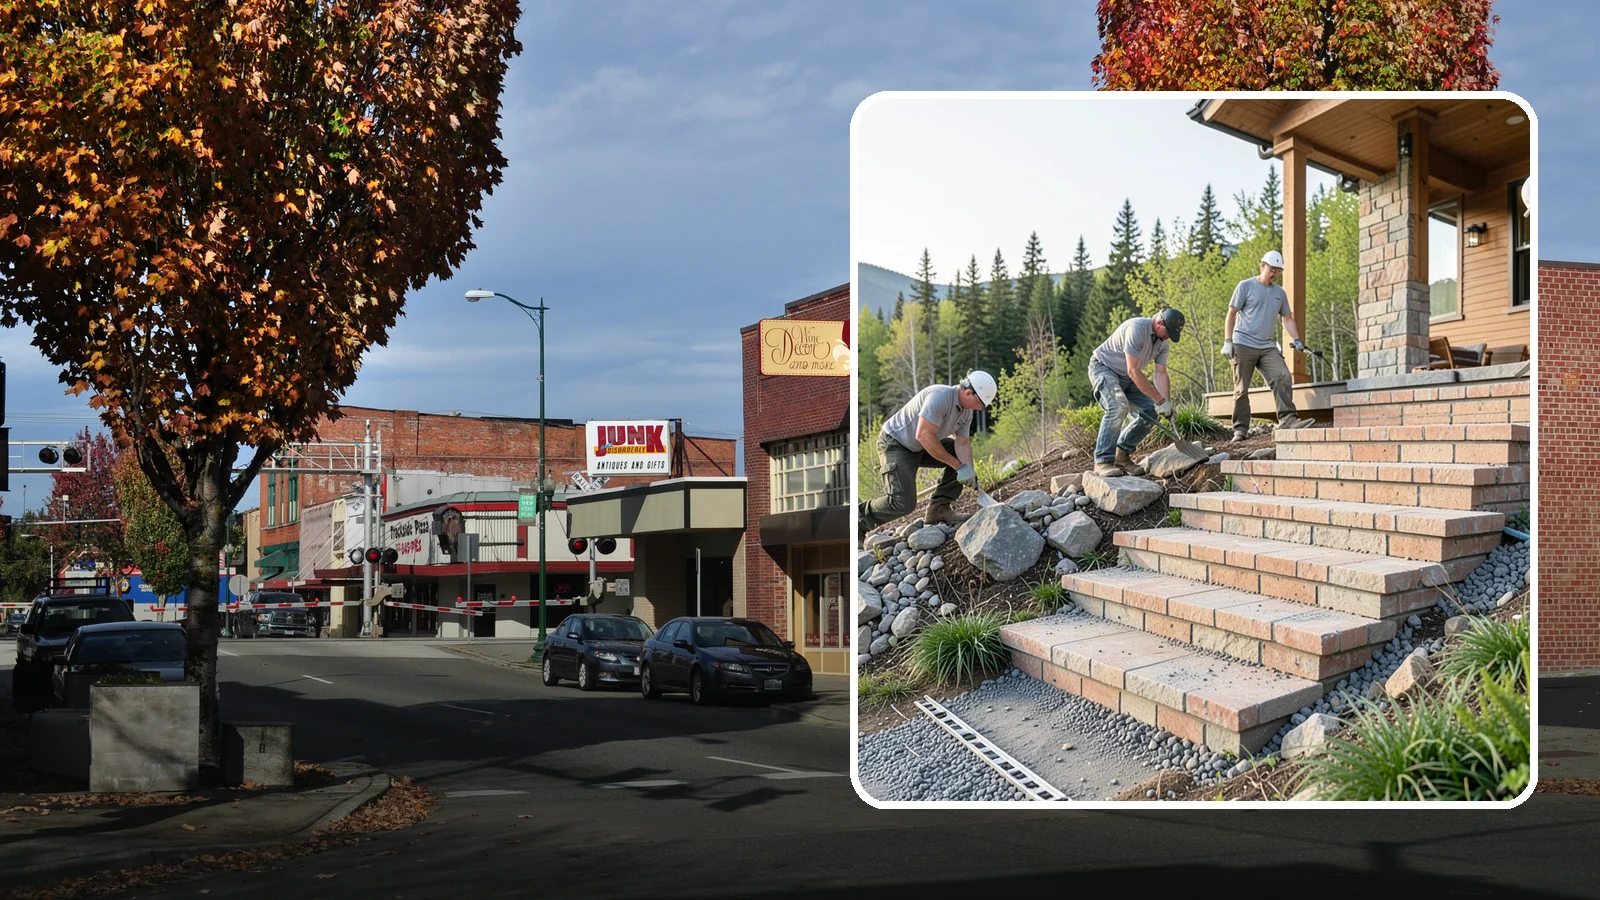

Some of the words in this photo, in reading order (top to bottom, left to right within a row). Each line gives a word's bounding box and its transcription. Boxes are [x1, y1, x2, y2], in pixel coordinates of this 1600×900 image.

[595, 425, 664, 457] JUNK
[607, 446, 646, 454] DISORDERLY
[596, 461, 628, 470] ANTIQUES
[631, 461, 644, 470] AND
[647, 460, 665, 469] GIFTS
